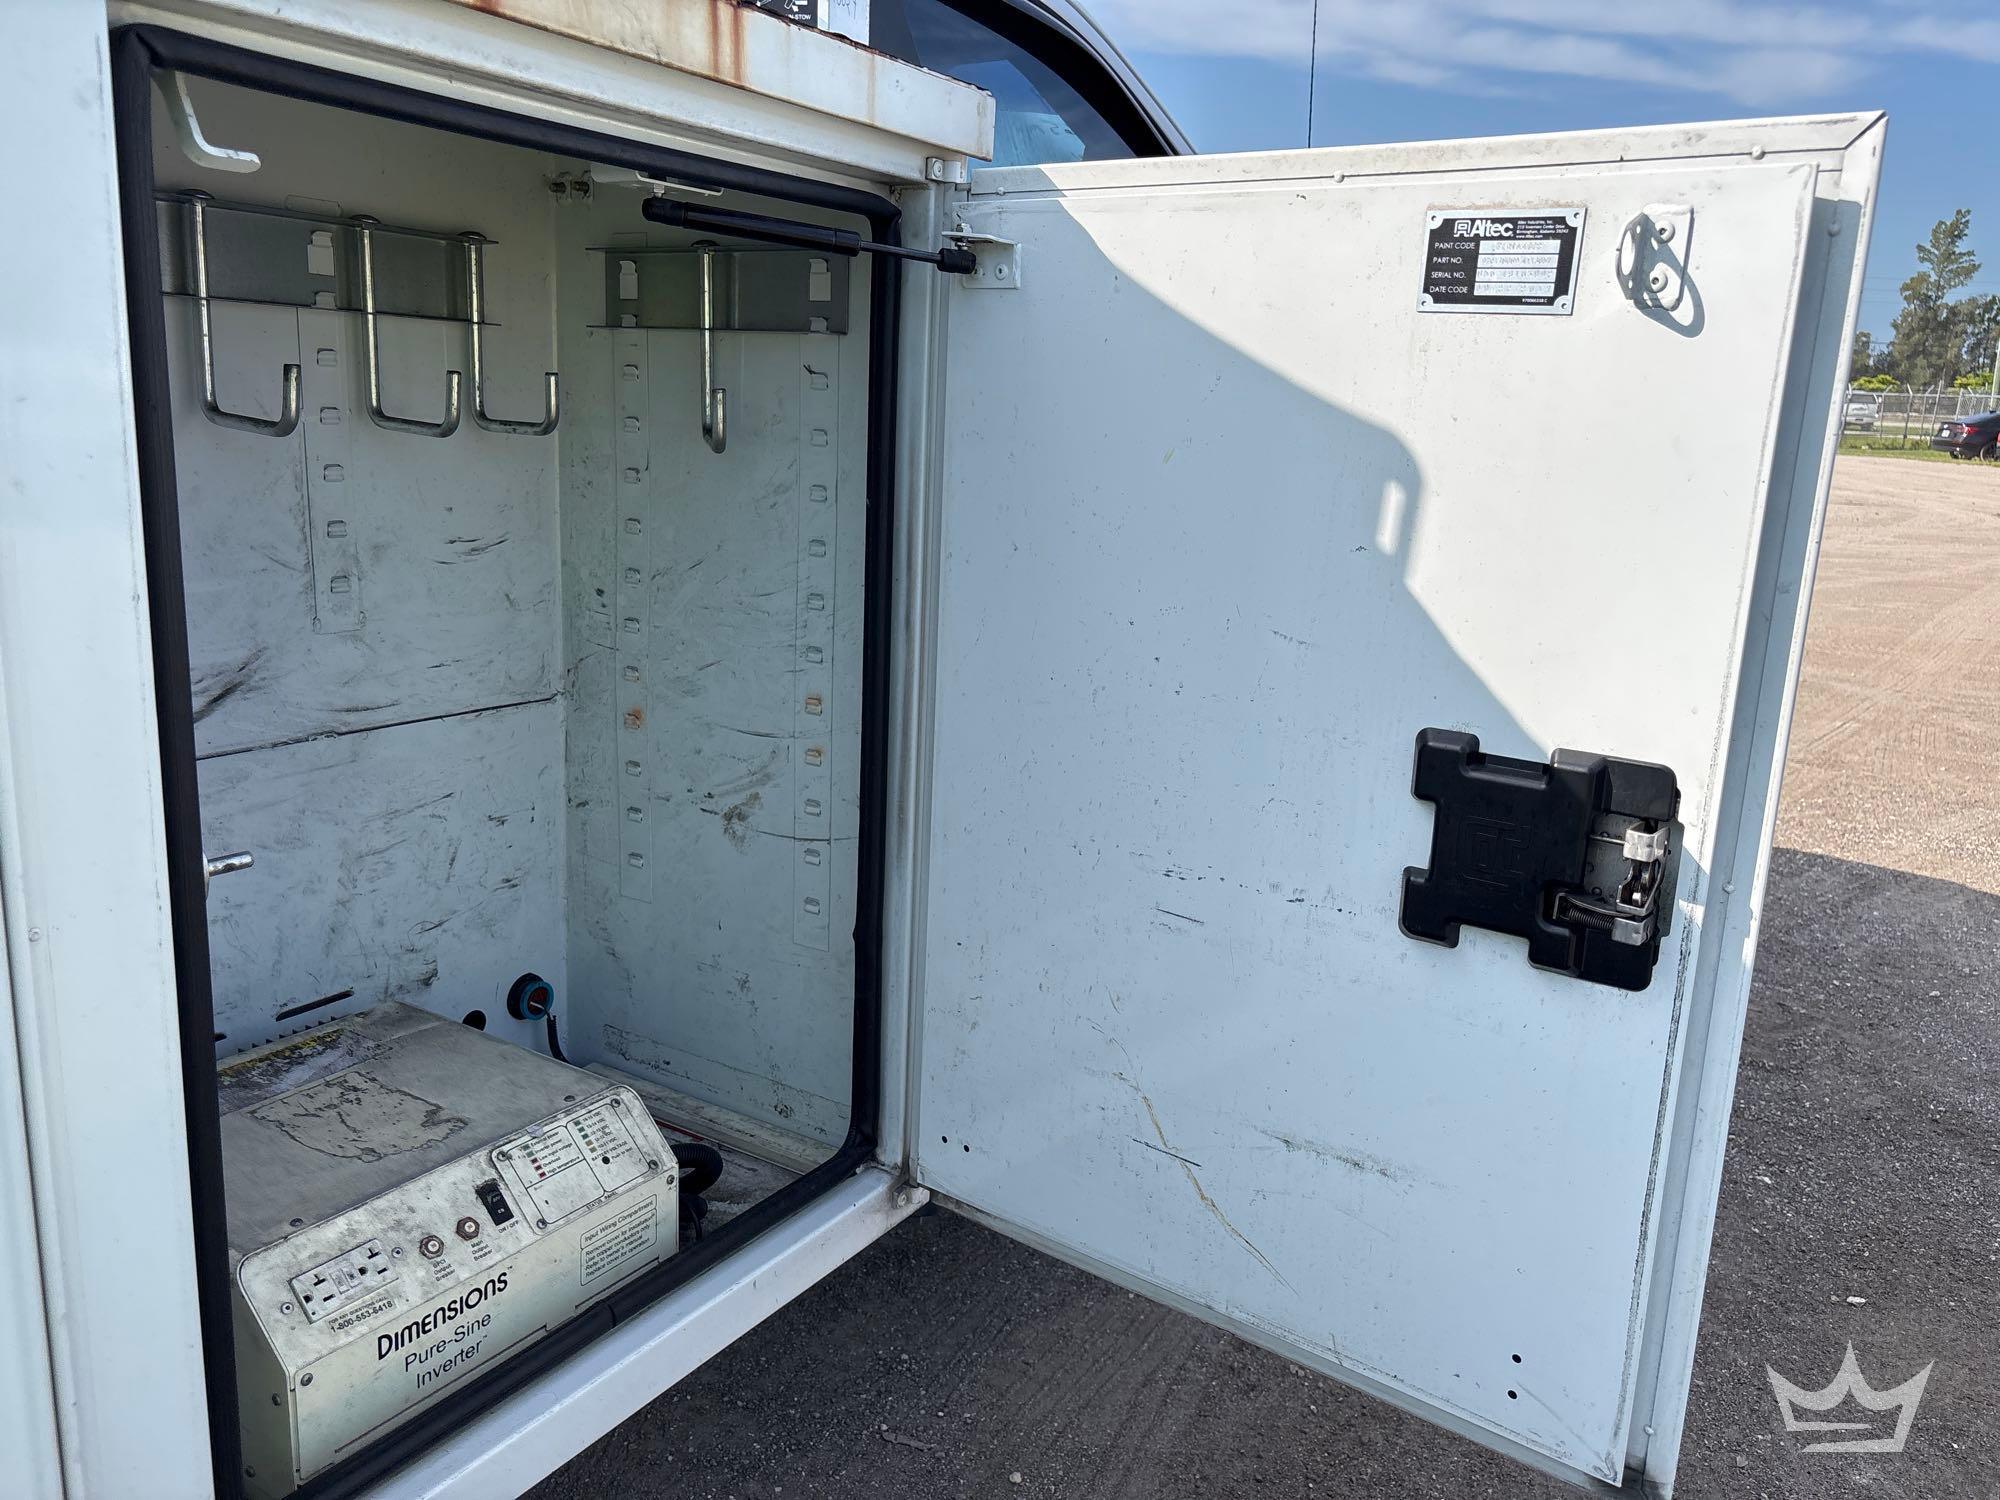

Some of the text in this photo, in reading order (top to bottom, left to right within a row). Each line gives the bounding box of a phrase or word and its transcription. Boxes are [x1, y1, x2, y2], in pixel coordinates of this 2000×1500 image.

[1470, 219, 1514, 238] Altec
[1431, 271, 1466, 279] SERIAL NO.
[584, 1200, 654, 1242] Input Wiring Compartment
[471, 1240, 483, 1248] Main
[472, 1244, 489, 1255] Output
[474, 1249, 493, 1261] Breaker
[434, 1264, 452, 1275] Output
[435, 1269, 455, 1282] Breaker
[330, 1300, 393, 1333] 1-800-553-6418
[405, 1313, 491, 1372] Pure-Sine
